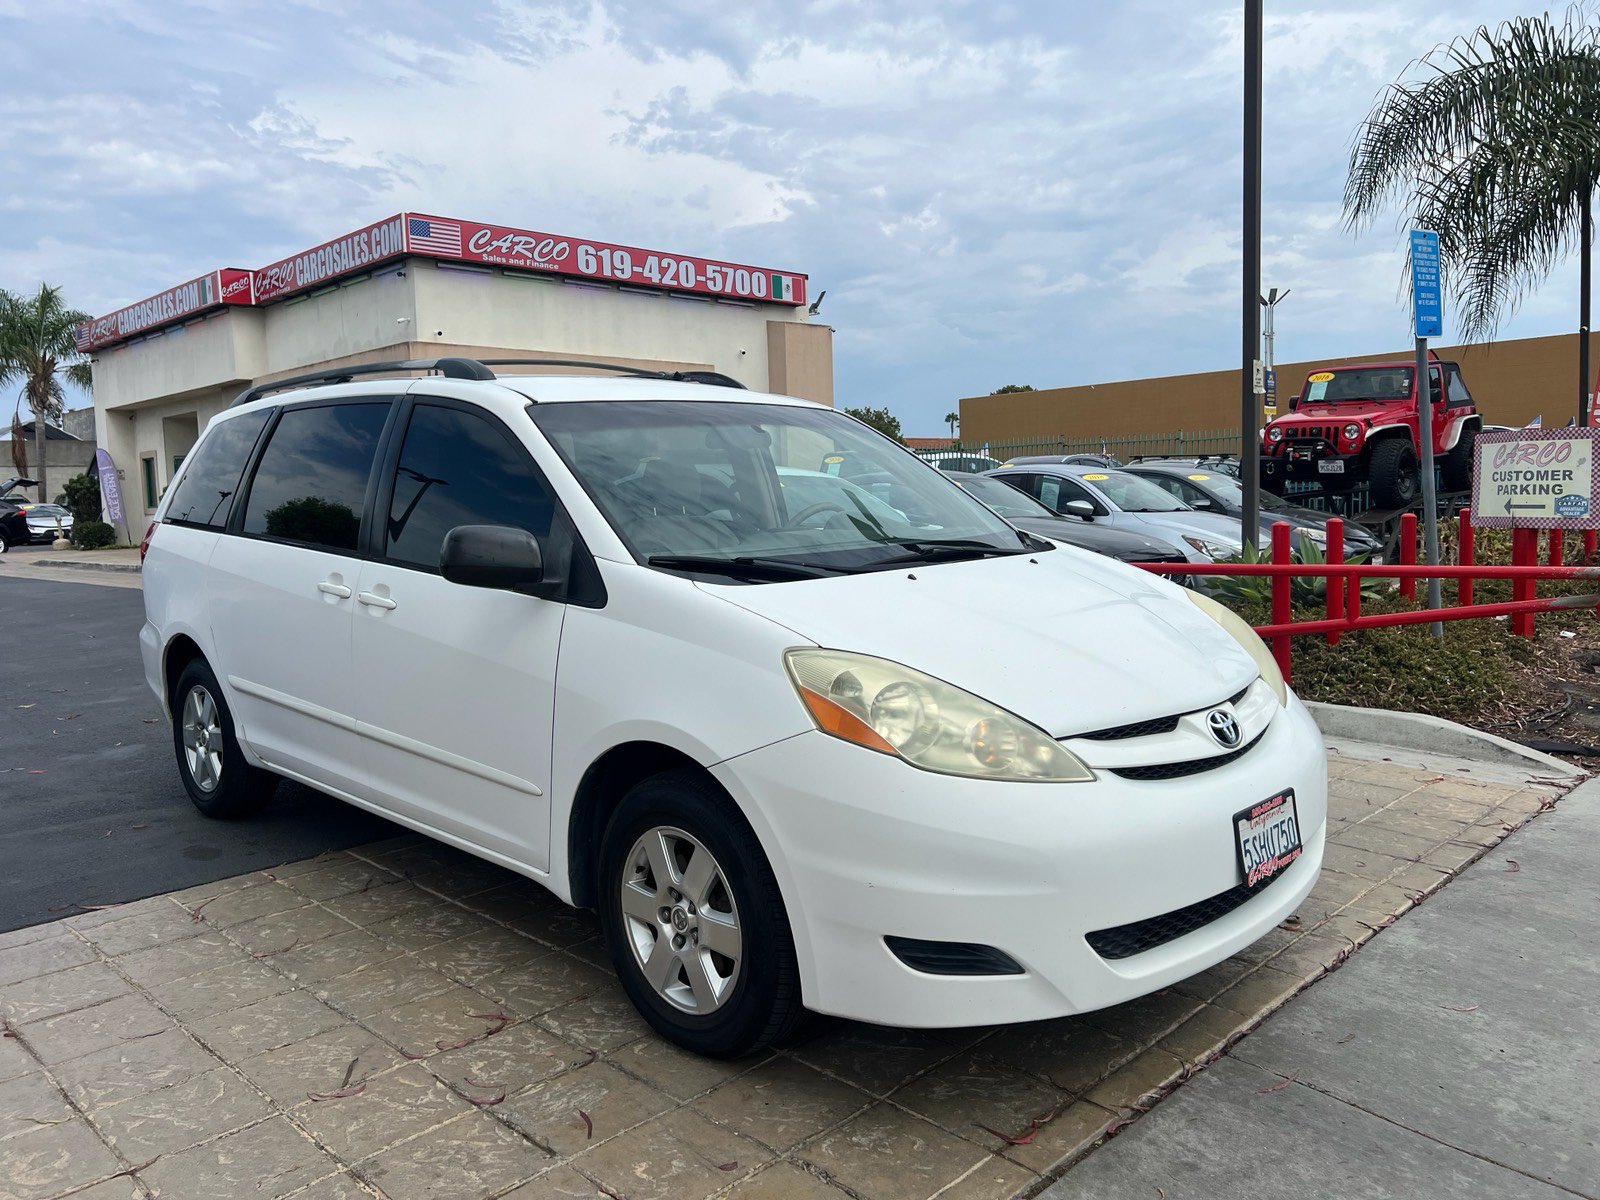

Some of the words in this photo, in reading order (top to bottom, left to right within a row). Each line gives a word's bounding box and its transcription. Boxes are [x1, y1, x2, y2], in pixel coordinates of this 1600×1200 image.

[295, 218, 402, 287] CARCOSALES.COM
[468, 228, 570, 262] CARCO
[482, 253, 506, 263] Sales
[508, 257, 525, 266] and
[526, 259, 559, 270] Finance
[576, 243, 767, 298] 619-420-5700
[221, 277, 249, 297] CARCO
[254, 261, 295, 297] CARCO
[117, 281, 200, 335] CARCOSALES.COM
[89, 314, 116, 342] CARCO
[1493, 441, 1572, 469] CARCO
[1492, 469, 1573, 482] CUSTOMER
[1497, 484, 1564, 495] PARKING
[1242, 816, 1297, 871] 5SHU750
